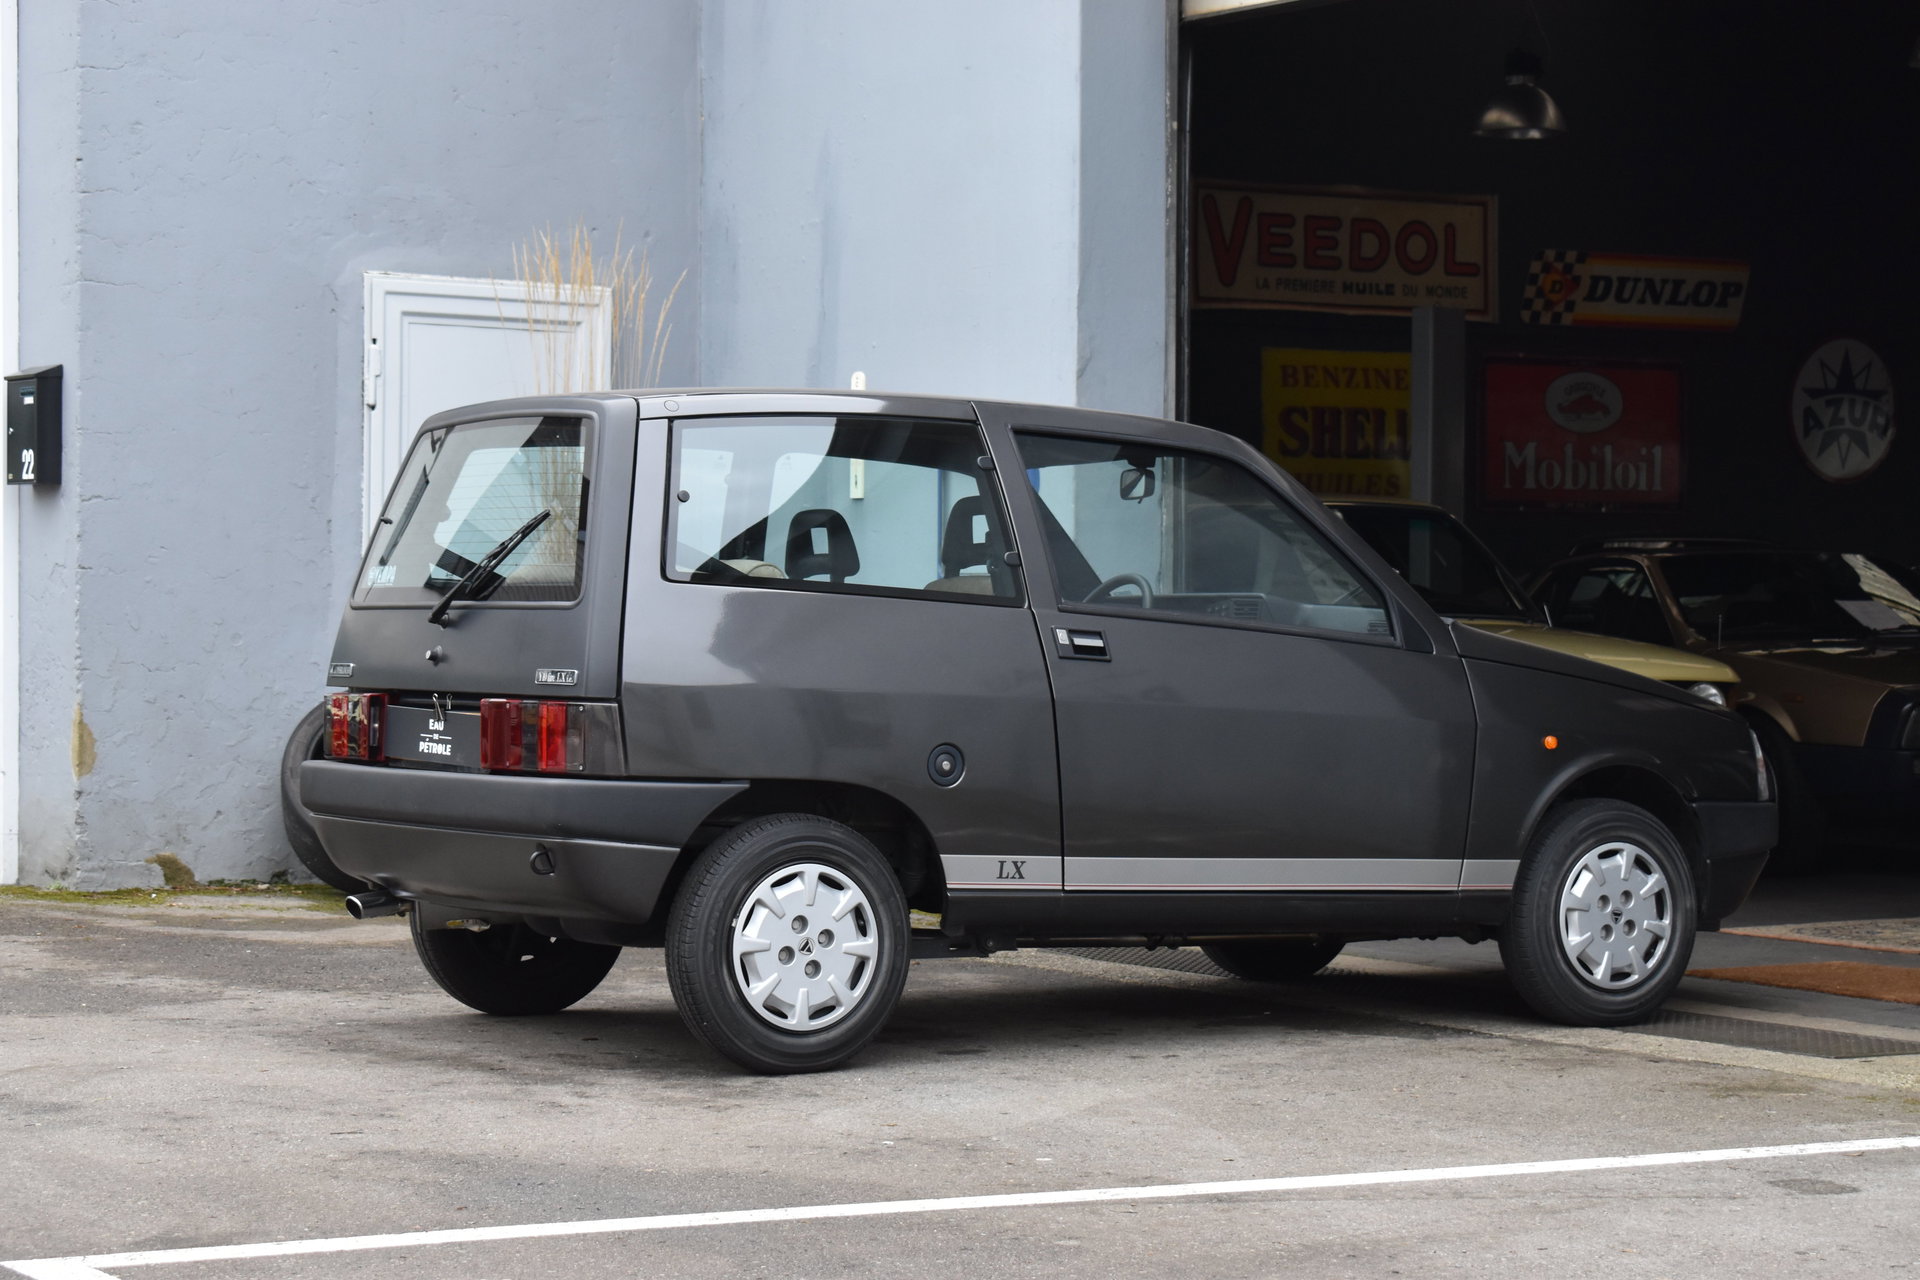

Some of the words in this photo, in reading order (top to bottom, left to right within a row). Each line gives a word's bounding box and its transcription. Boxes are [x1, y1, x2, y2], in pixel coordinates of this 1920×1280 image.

[1202, 194, 1480, 287] VEEDOL
[1255, 277, 1270, 290] LA
[1342, 283, 1395, 296] HUILE
[1402, 284, 1418, 298] DU
[1425, 285, 1468, 299] MONDE
[1582, 275, 1743, 308] DUNLOP
[1279, 365, 1409, 391] BENZINE
[1278, 406, 1411, 461] SHELL
[1802, 396, 1891, 441] AZUR
[21, 448, 35, 480] 22
[1502, 440, 1663, 491] Mobiloil
[429, 718, 444, 731] EAU
[418, 738, 452, 756] PÉTROLE
[996, 860, 1027, 880] LX
